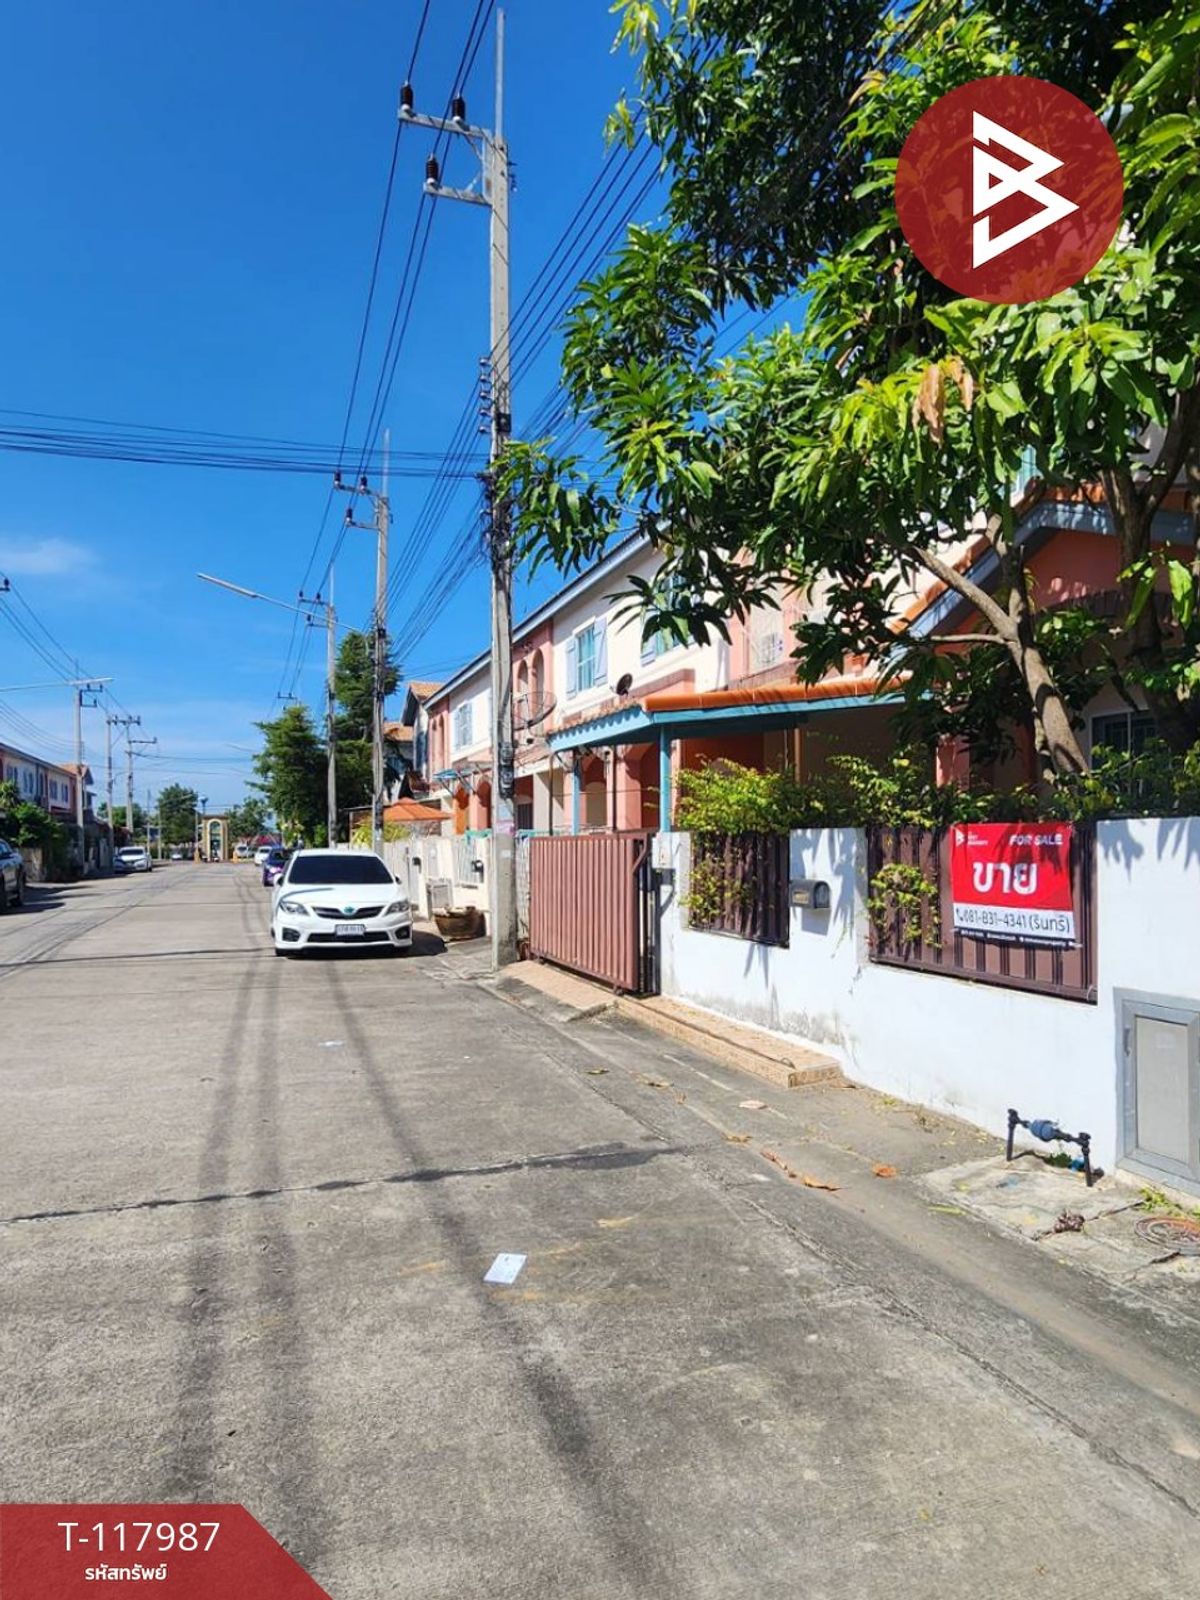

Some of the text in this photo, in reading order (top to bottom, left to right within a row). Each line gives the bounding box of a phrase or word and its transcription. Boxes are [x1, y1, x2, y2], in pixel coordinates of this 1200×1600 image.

[1009, 833, 1064, 846] FOR SALE
[973, 862, 1038, 895] ขาย
